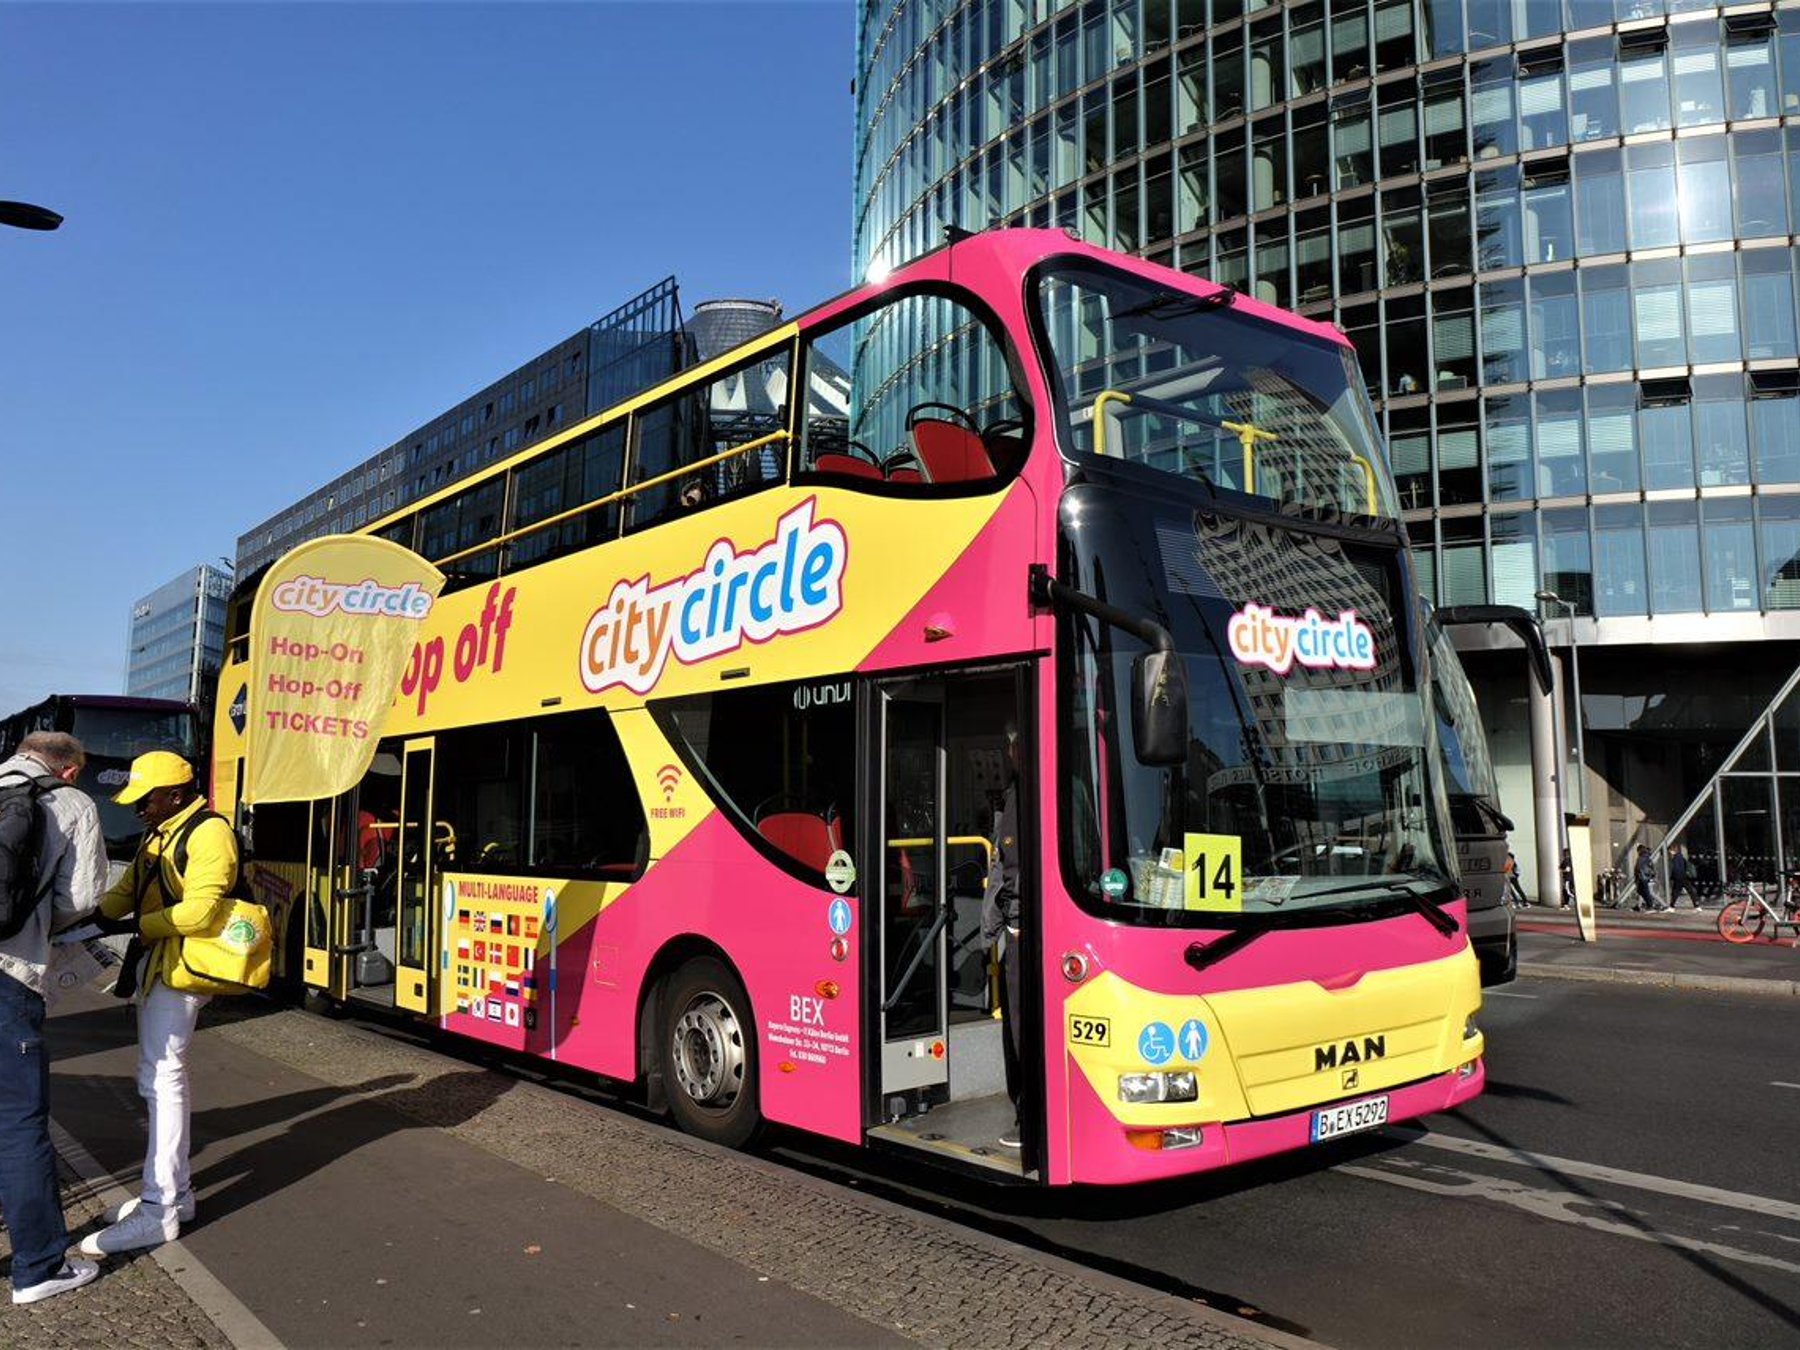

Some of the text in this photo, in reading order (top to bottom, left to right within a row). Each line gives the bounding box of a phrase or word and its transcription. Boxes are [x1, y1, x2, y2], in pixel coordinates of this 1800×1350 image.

[270, 636, 364, 664] Hop-On
[393, 581, 516, 716] op off
[1234, 613, 1369, 663] city circle
[268, 673, 363, 701] Hop-Off
[266, 711, 369, 739] TICKETS
[651, 807, 668, 818] FREE
[1191, 852, 1235, 899] 14
[458, 880, 538, 904] MULTI-LANGUAGE
[790, 994, 825, 1026] BEX
[1073, 1019, 1107, 1041] 529
[1314, 1034, 1386, 1072] MAN
